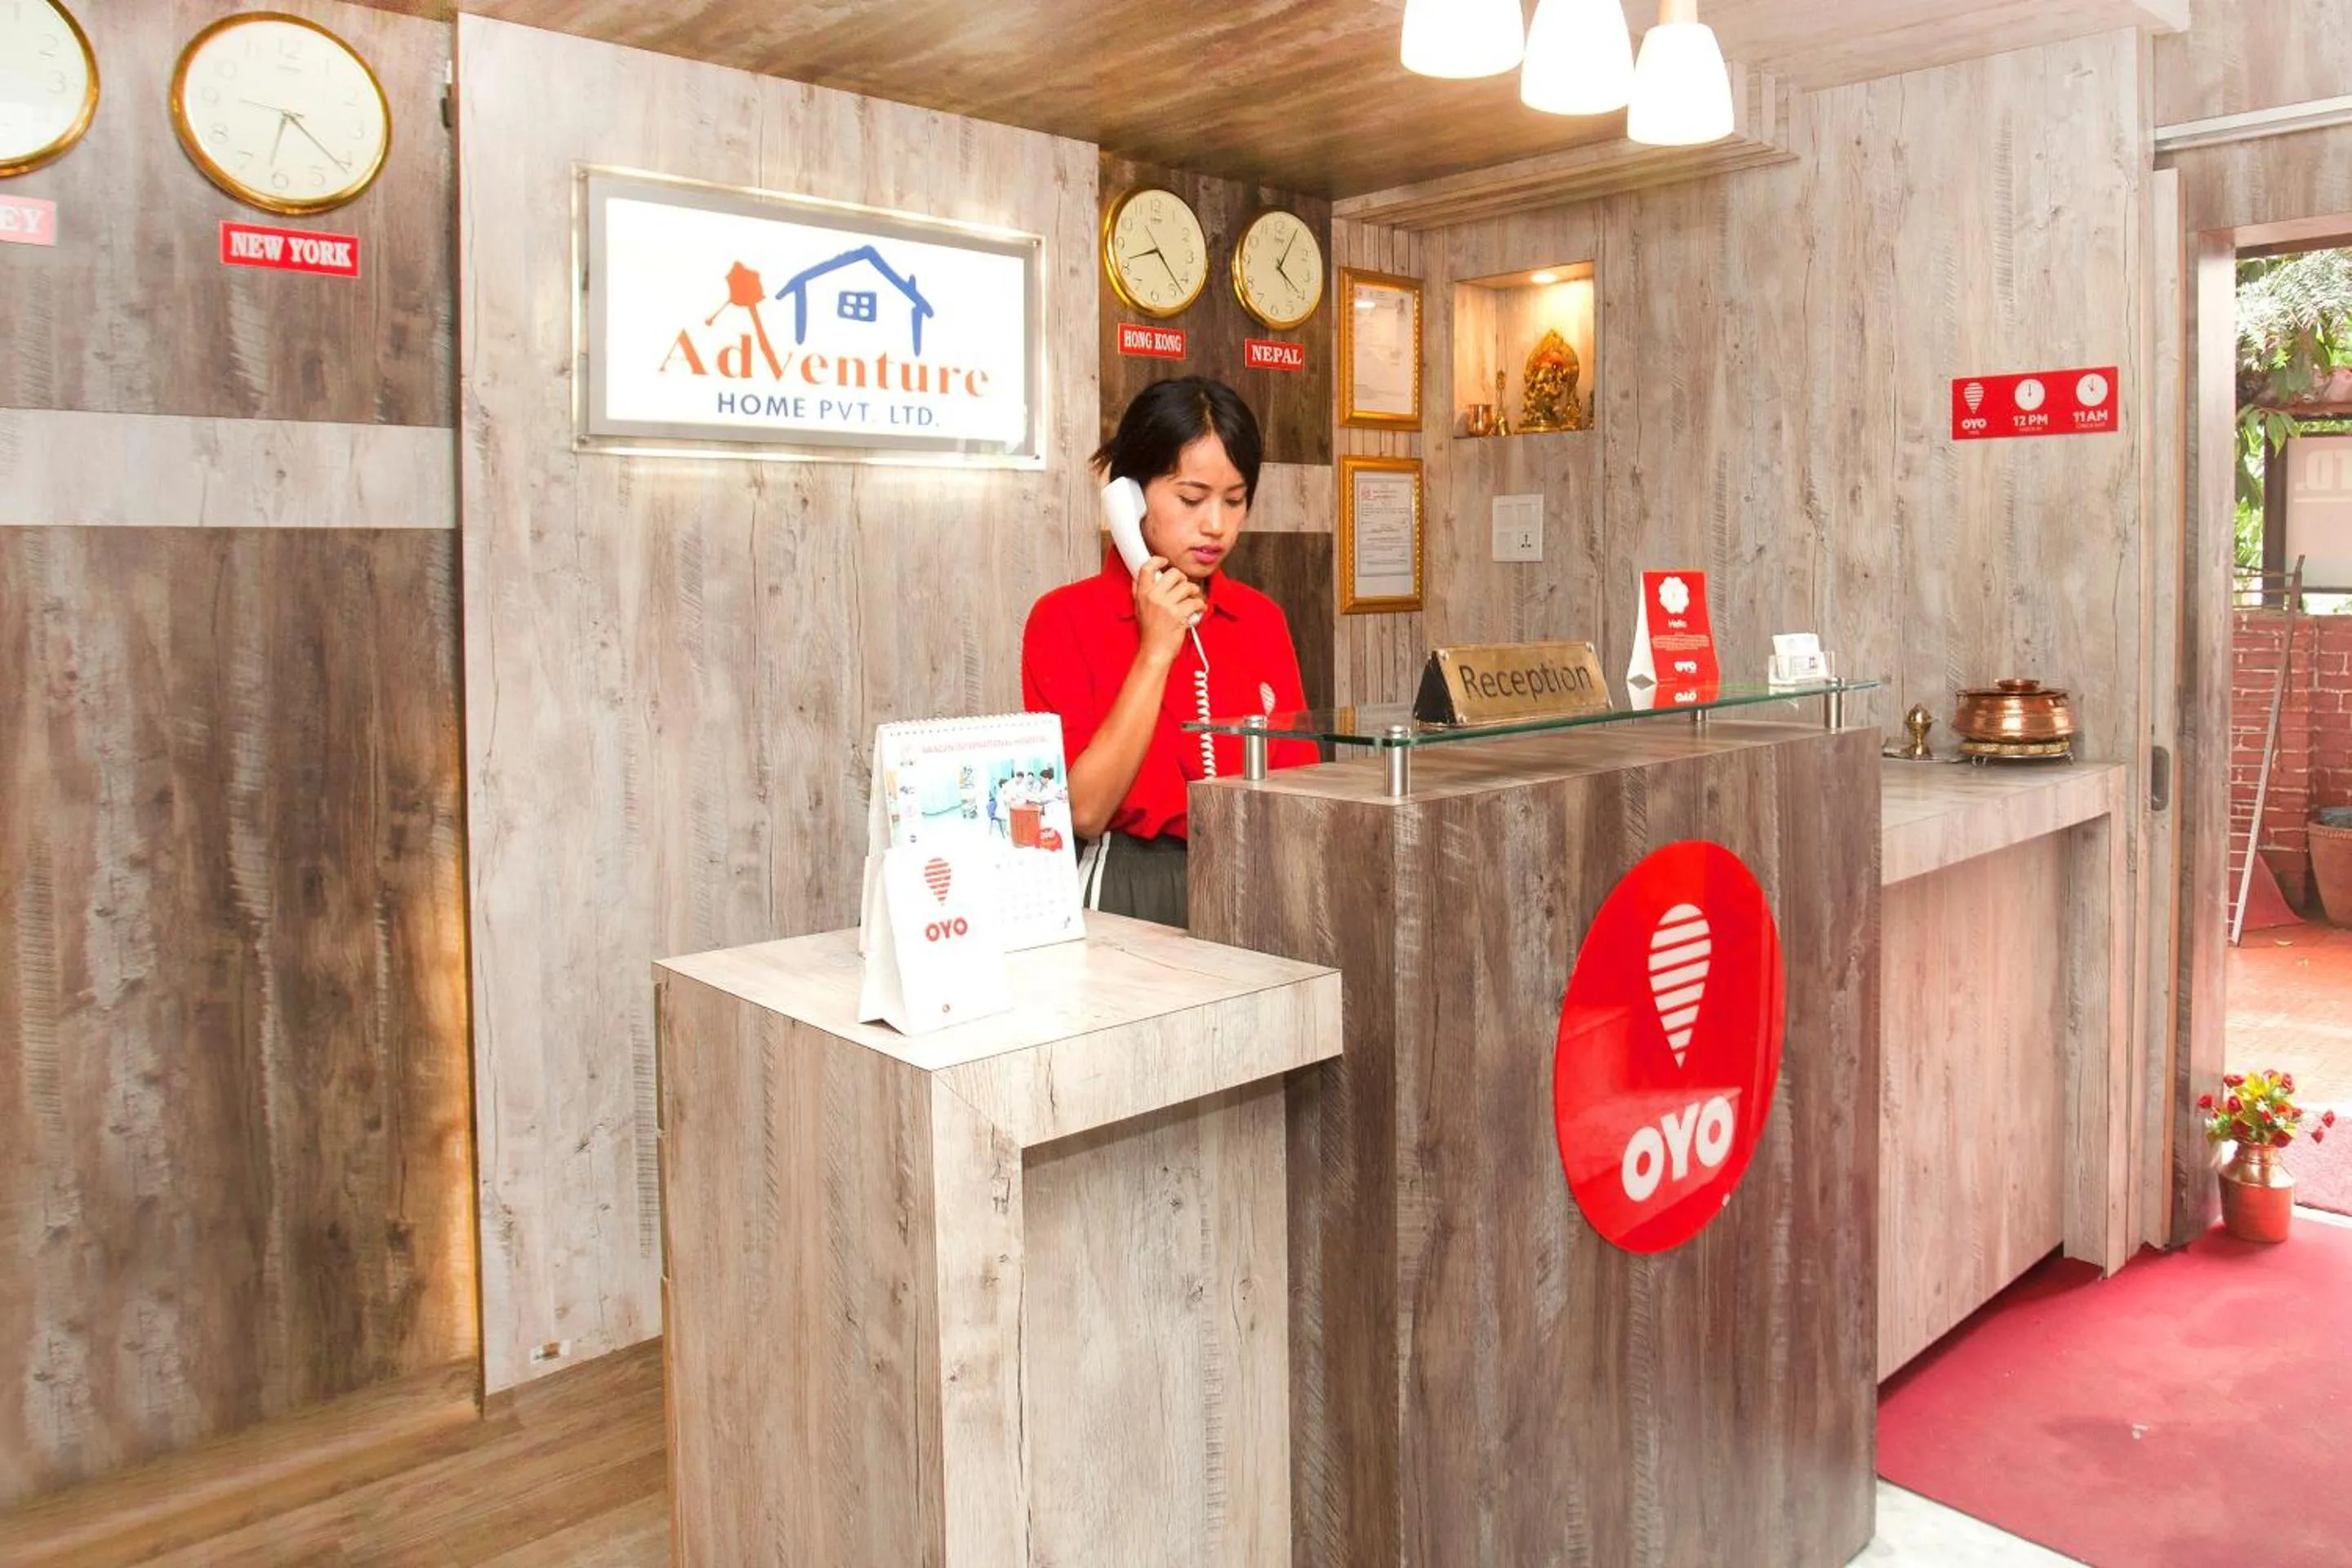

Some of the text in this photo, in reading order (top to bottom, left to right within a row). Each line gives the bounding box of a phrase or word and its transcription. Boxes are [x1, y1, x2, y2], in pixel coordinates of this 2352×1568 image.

[230, 231, 353, 268] NEW YORK
[1123, 329, 1182, 352] HONG KONG
[1251, 345, 1302, 365] NEPAL
[718, 392, 806, 418] HOME
[889, 404, 940, 427] LTD.
[2012, 413, 2048, 427] 12 PM
[2073, 410, 2108, 423] 11 AM
[1962, 418, 1987, 430] OYO
[1674, 661, 1697, 674] OYO
[1459, 662, 1593, 702] Reception
[925, 916, 968, 942] OYO
[1622, 1095, 1734, 1202] OYO
